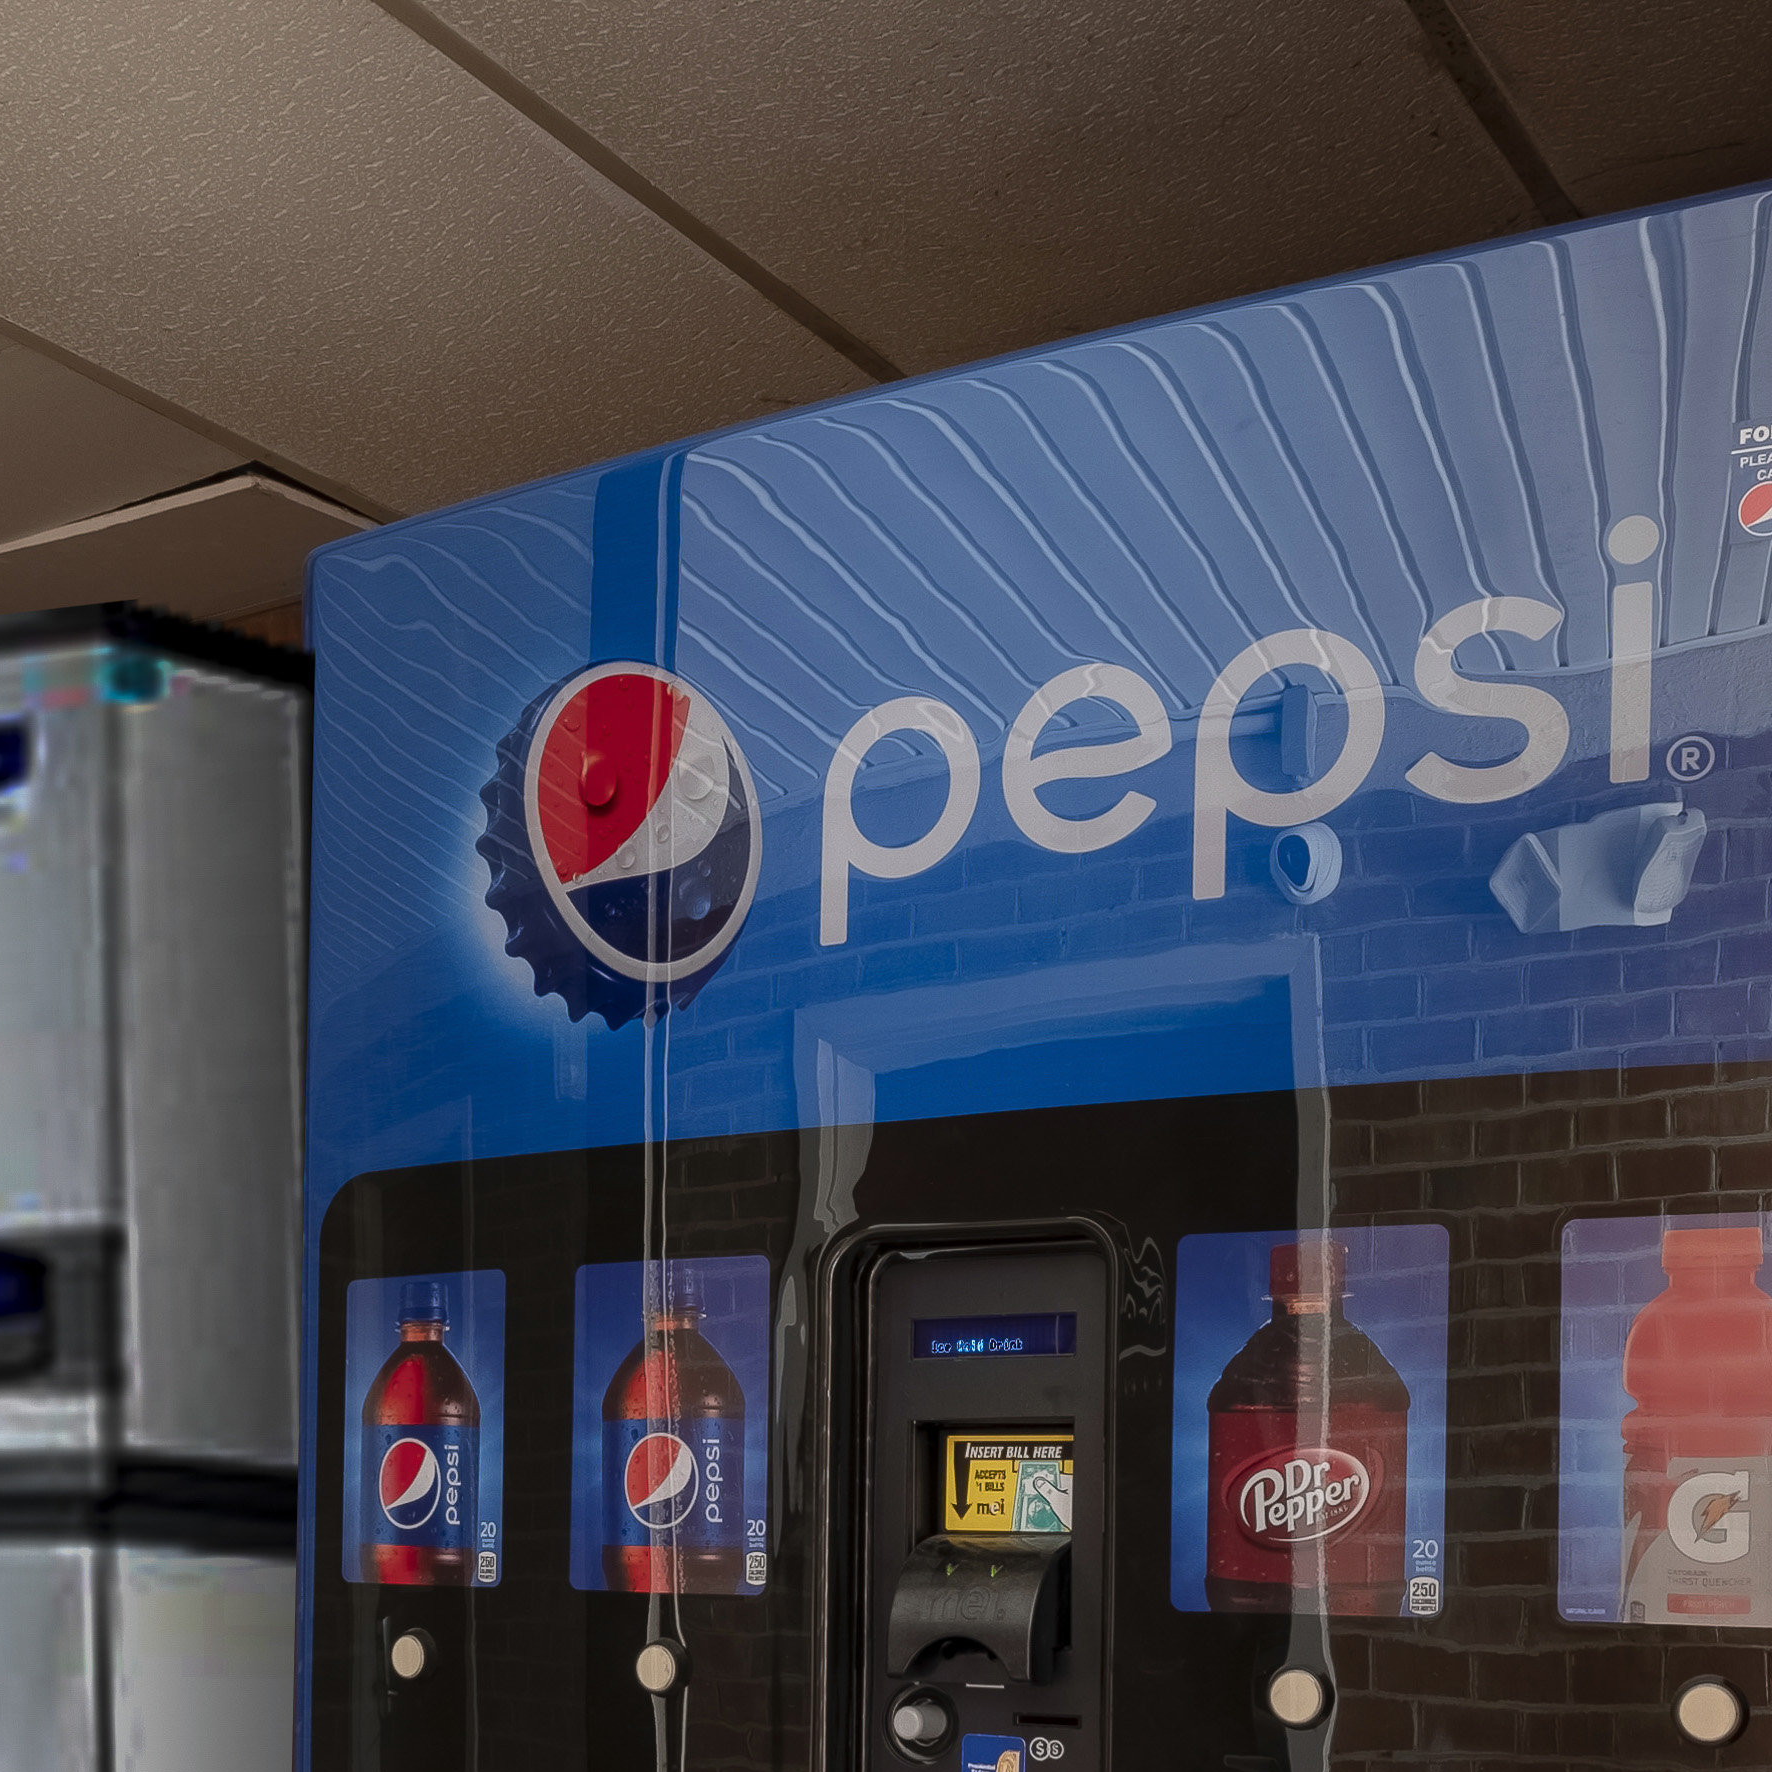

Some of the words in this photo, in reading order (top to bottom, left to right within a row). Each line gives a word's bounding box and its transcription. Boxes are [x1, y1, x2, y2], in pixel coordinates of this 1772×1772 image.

[819, 515, 1660, 947] pepsi
[988, 1337, 1024, 1352] Drink
[965, 1442, 1004, 1459] INSERT
[1006, 1446, 1029, 1459] BILL
[1032, 1445, 1063, 1459] HERE
[444, 1444, 462, 1525] pepsi
[702, 1438, 724, 1523] pepsi
[1284, 1458, 1331, 1499] Dr
[976, 1498, 1005, 1516] mei
[1240, 1468, 1360, 1533] Pepper
[1667, 1469, 1751, 1565] G
[480, 1521, 497, 1538] 20
[747, 1519, 766, 1537] 20
[1412, 1539, 1439, 1559] 20
[1412, 1582, 1437, 1597] 250
